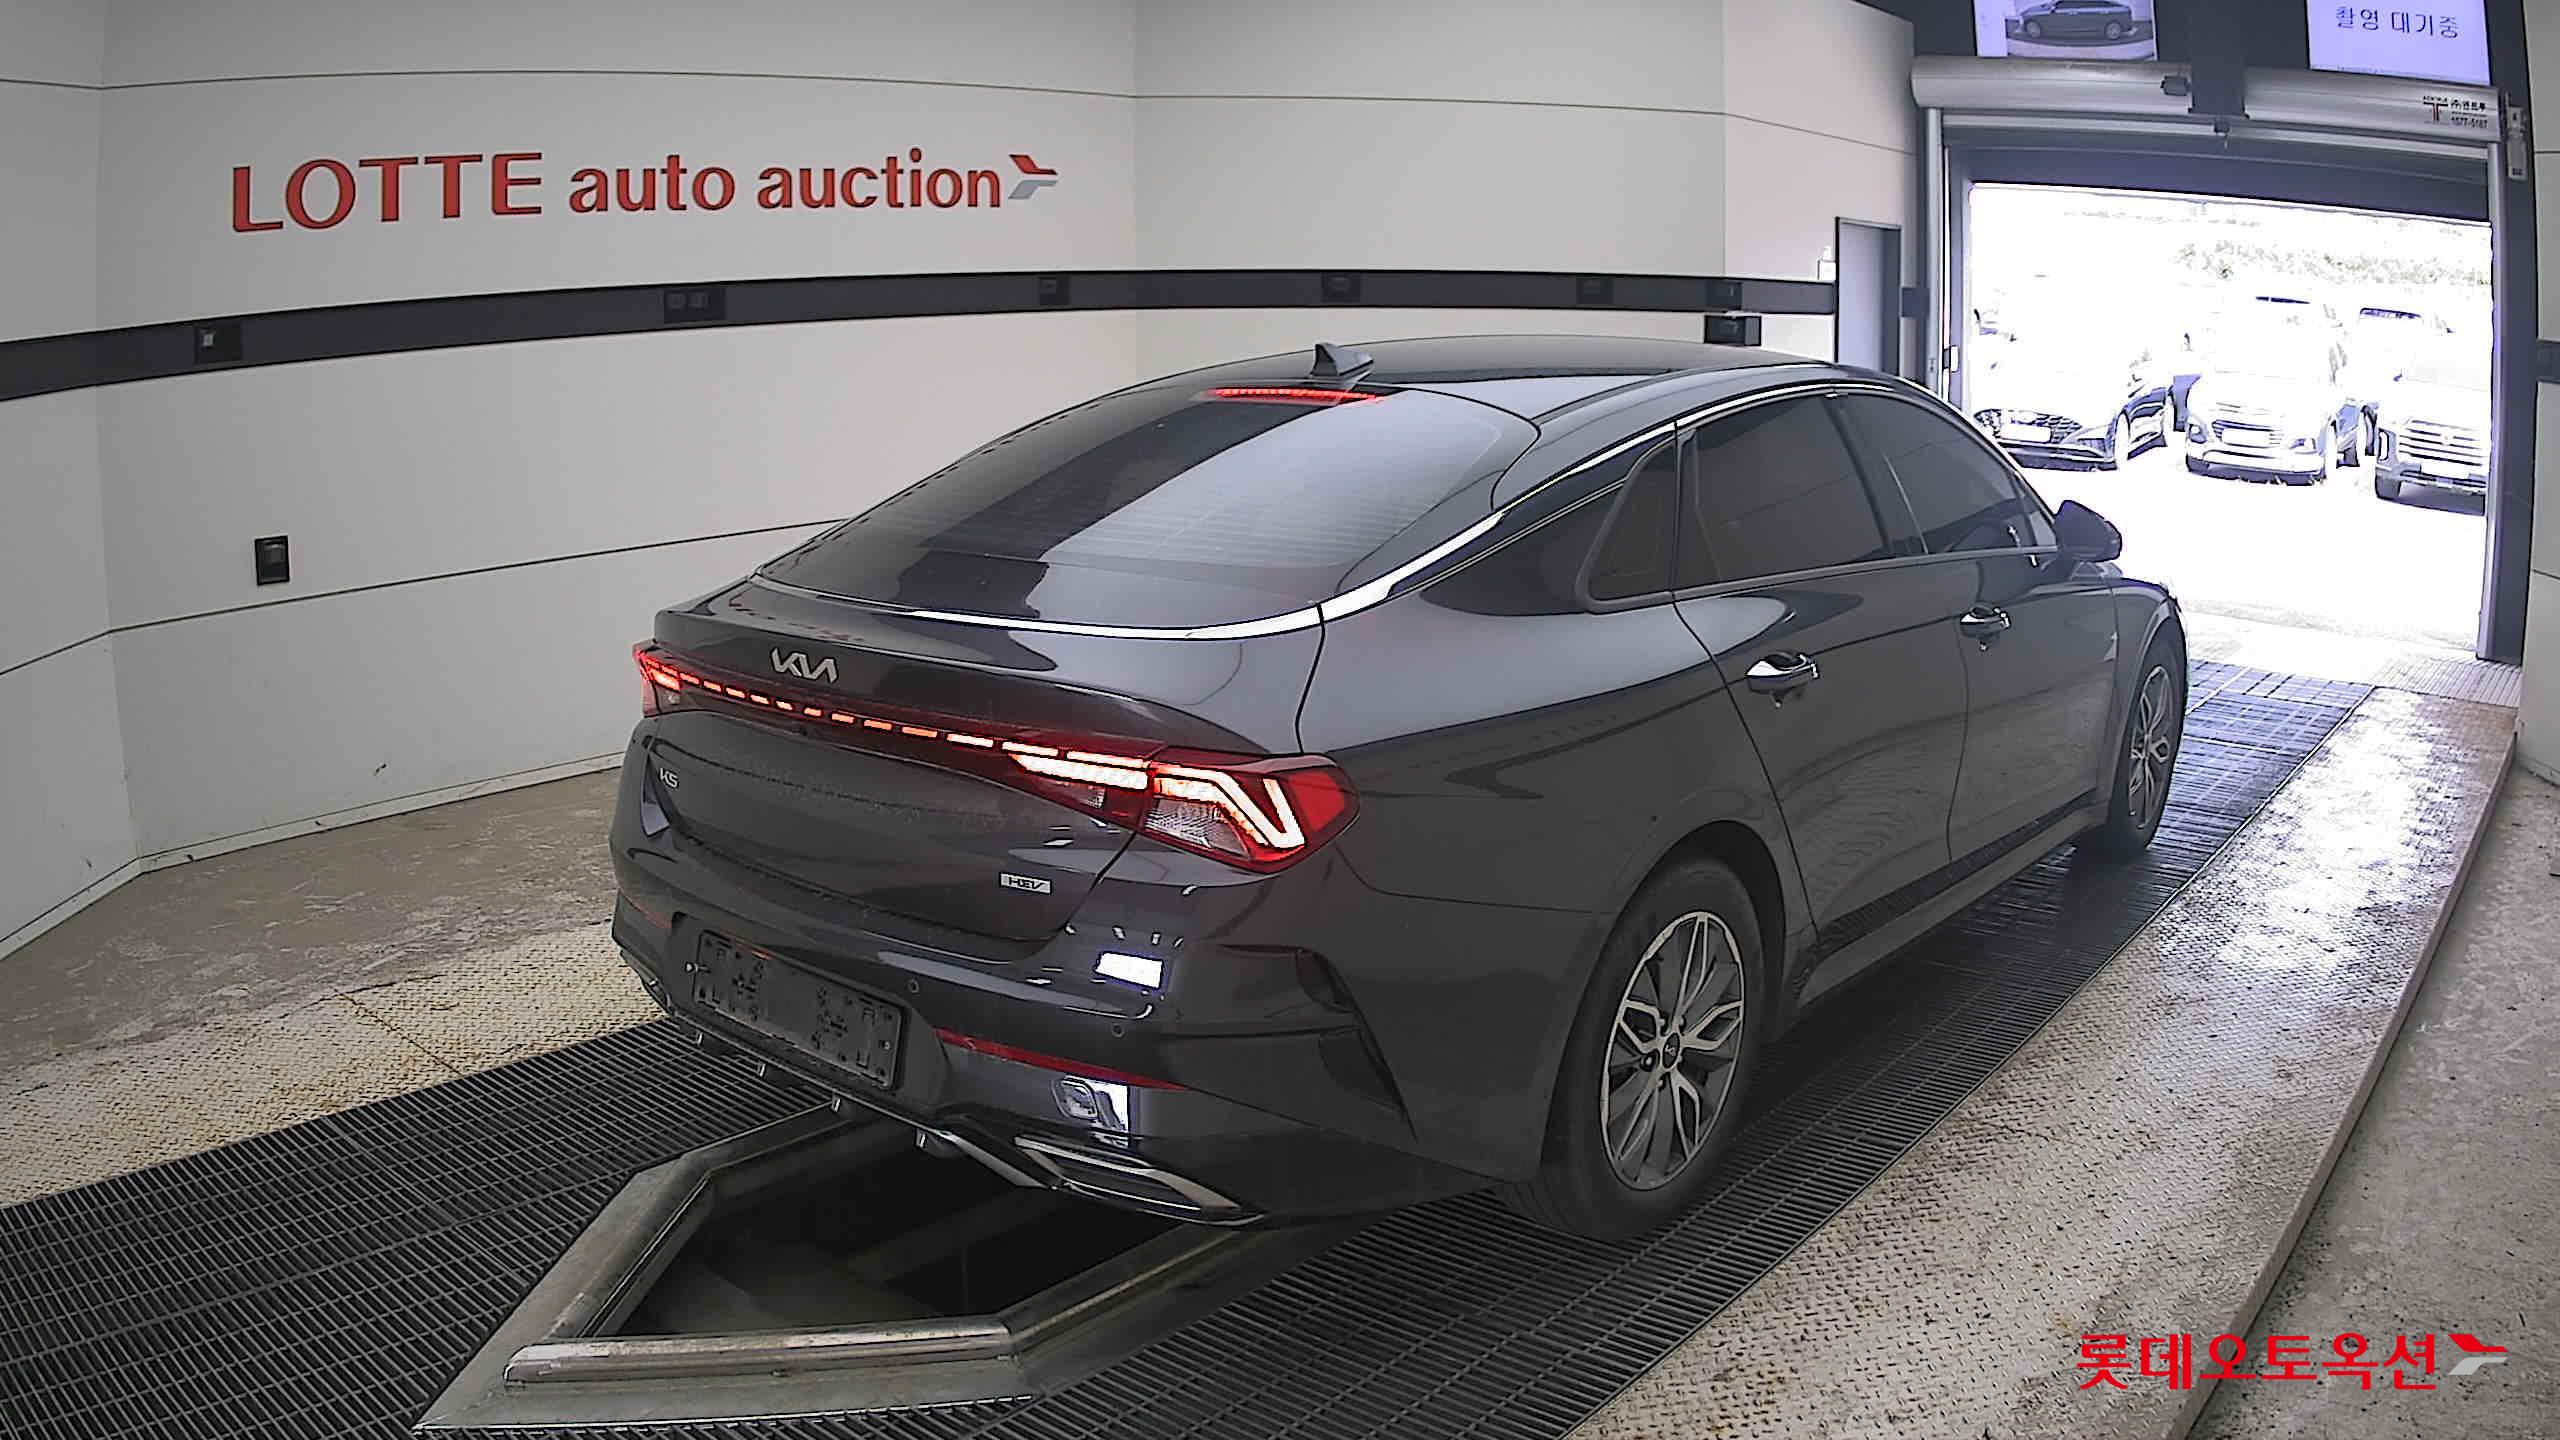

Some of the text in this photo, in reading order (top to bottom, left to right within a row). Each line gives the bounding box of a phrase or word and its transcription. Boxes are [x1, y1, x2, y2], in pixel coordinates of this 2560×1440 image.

[2336, 6, 2459, 39] 촬영 대기중
[232, 147, 1001, 232] LOTTE auto auction
